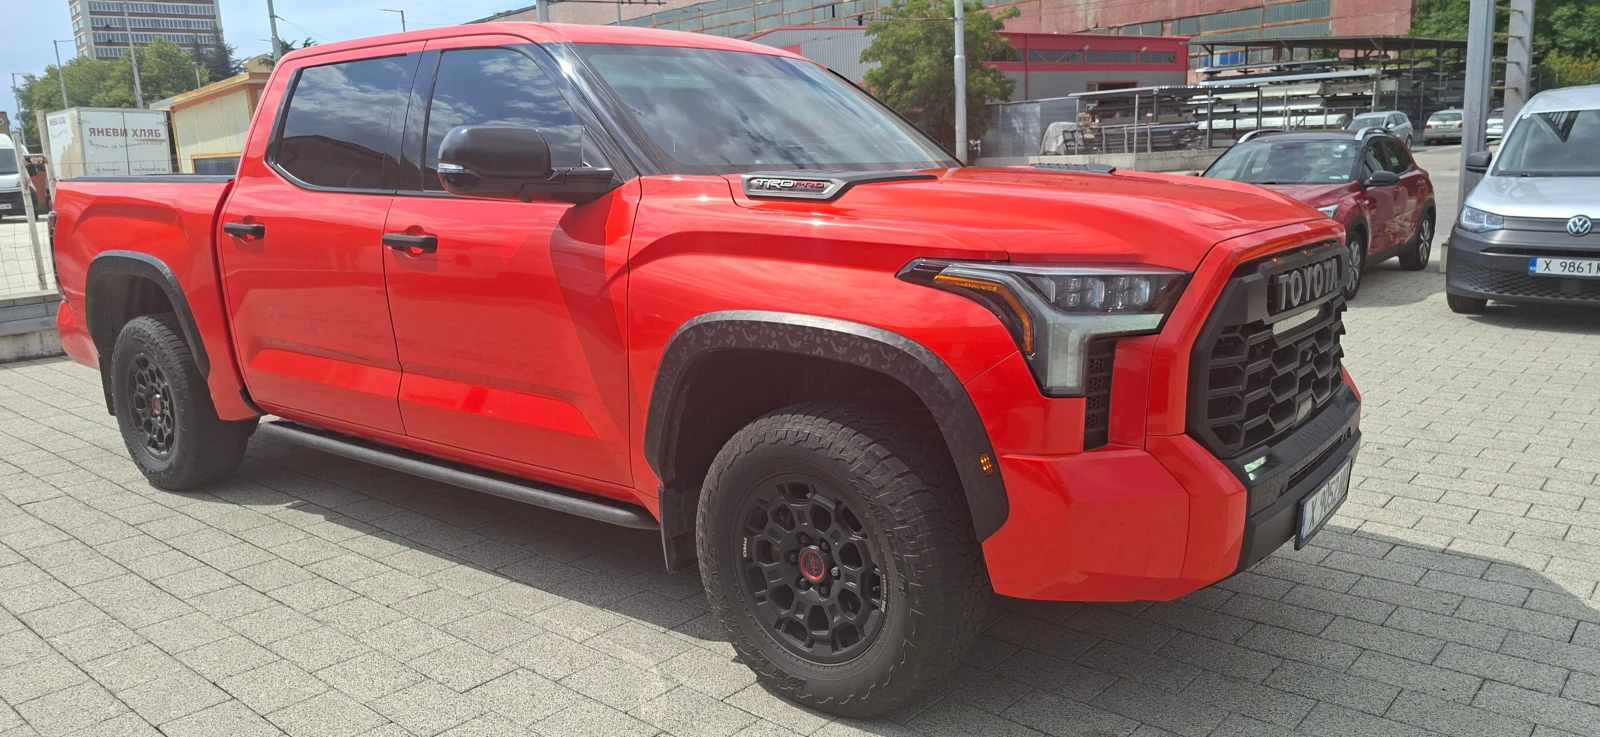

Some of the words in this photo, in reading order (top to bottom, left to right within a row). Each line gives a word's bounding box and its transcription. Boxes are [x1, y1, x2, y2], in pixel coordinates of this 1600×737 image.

[88, 127, 128, 137] ЯНЕВИ
[131, 128, 161, 138] ХЛЯБ
[751, 179, 793, 189] TRD
[1559, 260, 1593, 274] 9861
[1277, 258, 1338, 311] TOYOTA
